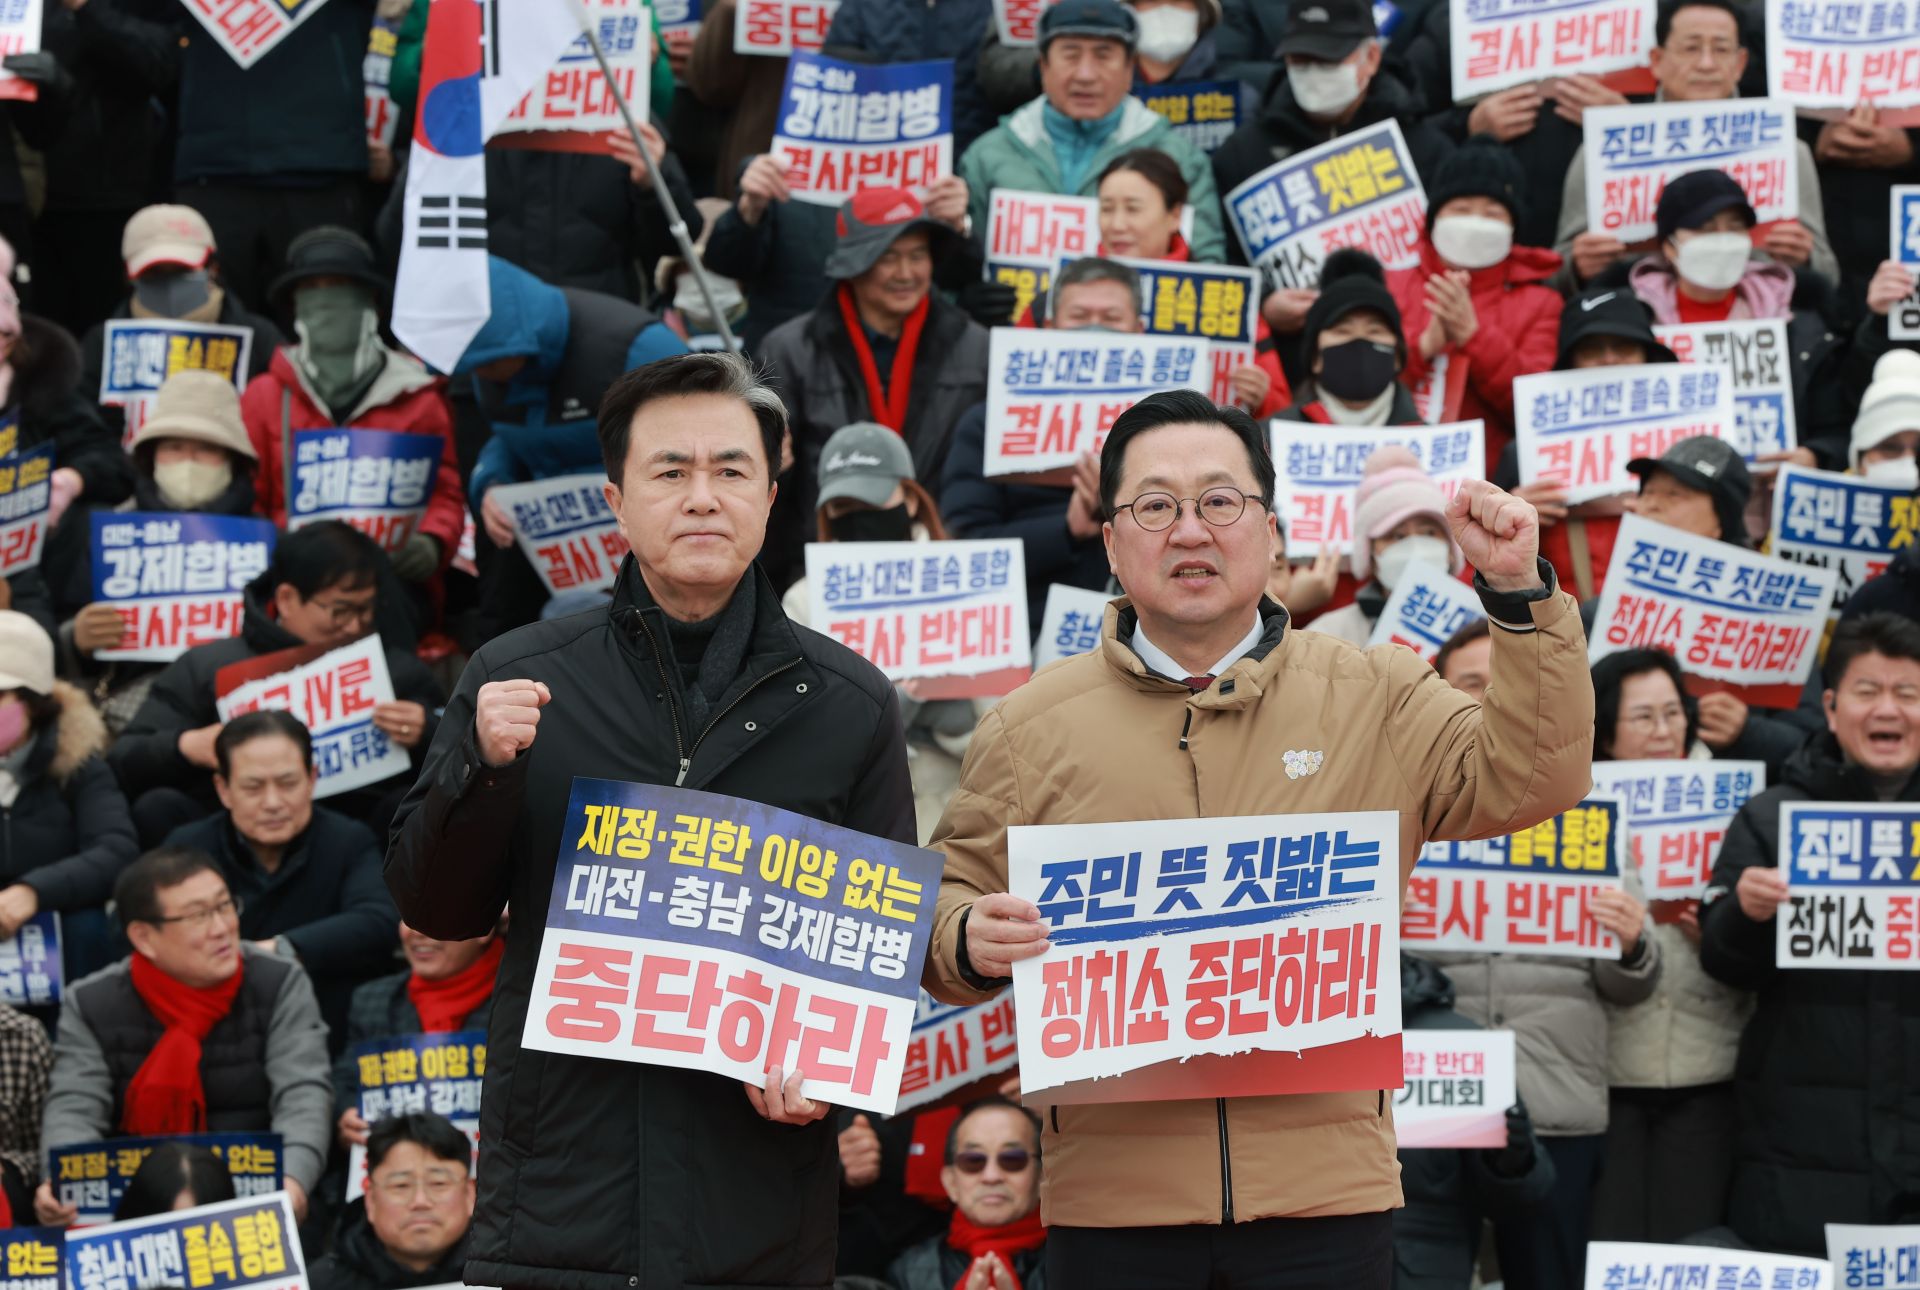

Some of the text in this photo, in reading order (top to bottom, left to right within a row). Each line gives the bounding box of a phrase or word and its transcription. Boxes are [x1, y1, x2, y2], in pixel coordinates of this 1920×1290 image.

[195, 0, 283, 57] 대!
[1467, 9, 1641, 79] 결사 반대!
[544, 68, 635, 118] 반대!
[1782, 49, 1848, 95] 결사
[783, 84, 941, 142] 강제합병
[1601, 108, 1784, 160] 주민 뜻 짓밟는
[782, 143, 939, 191] 결사반대
[1237, 143, 1405, 249] 주민 뜻 짓밟는
[1154, 276, 1245, 338] 졸속 통합
[1003, 347, 1099, 385] 충남·대전
[1104, 346, 1146, 384] 졸속
[1151, 345, 1197, 384] 통합
[1532, 371, 1720, 429] 충남·대전 졸속 통합
[1000, 403, 1082, 455] 결사
[1431, 431, 1471, 471] 통합
[294, 455, 433, 513] 강제합병
[1536, 435, 1614, 490] 결사
[513, 491, 582, 533] 충남·대전
[1786, 481, 1848, 543] 주민
[1850, 492, 1883, 549] 뜻
[102, 541, 268, 598] 강제합병
[537, 542, 602, 590] 결사
[824, 549, 1011, 602] 충남·대전 졸속 통합
[1626, 541, 1688, 585] 주민
[1692, 558, 1726, 595] 뜻
[1728, 566, 1822, 611] 짓밟는
[107, 600, 244, 651] 결사반
[828, 604, 1012, 669] 결사 반대!
[1688, 614, 1812, 673] 중단하라!
[304, 657, 375, 729] 결사
[1662, 774, 1705, 812] 졸속
[1713, 770, 1753, 810] 통합
[577, 804, 923, 923] 재정·권한 이양 없는
[1560, 805, 1609, 871] 통합
[1796, 818, 1862, 880] 주민
[1868, 820, 1904, 881] 뜻
[1037, 829, 1380, 926] 주민 뜻 짓밟는
[758, 893, 913, 981] 강제합병
[1401, 877, 1489, 941] 결사
[1788, 895, 1874, 958] 정치쇼
[545, 942, 891, 1096] 중단하라
[1040, 922, 1382, 1059] 정치쇼 중단하라!
[421, 1045, 469, 1079] 이양
[1436, 1051, 1484, 1075] 반대
[430, 1080, 482, 1115] 강제
[60, 1145, 277, 1180] 재정·권 없는
[61, 1178, 132, 1208] 대전-
[7, 1241, 58, 1276] 없는
[183, 1224, 236, 1288] 졸속
[233, 1208, 286, 1279] 통합
